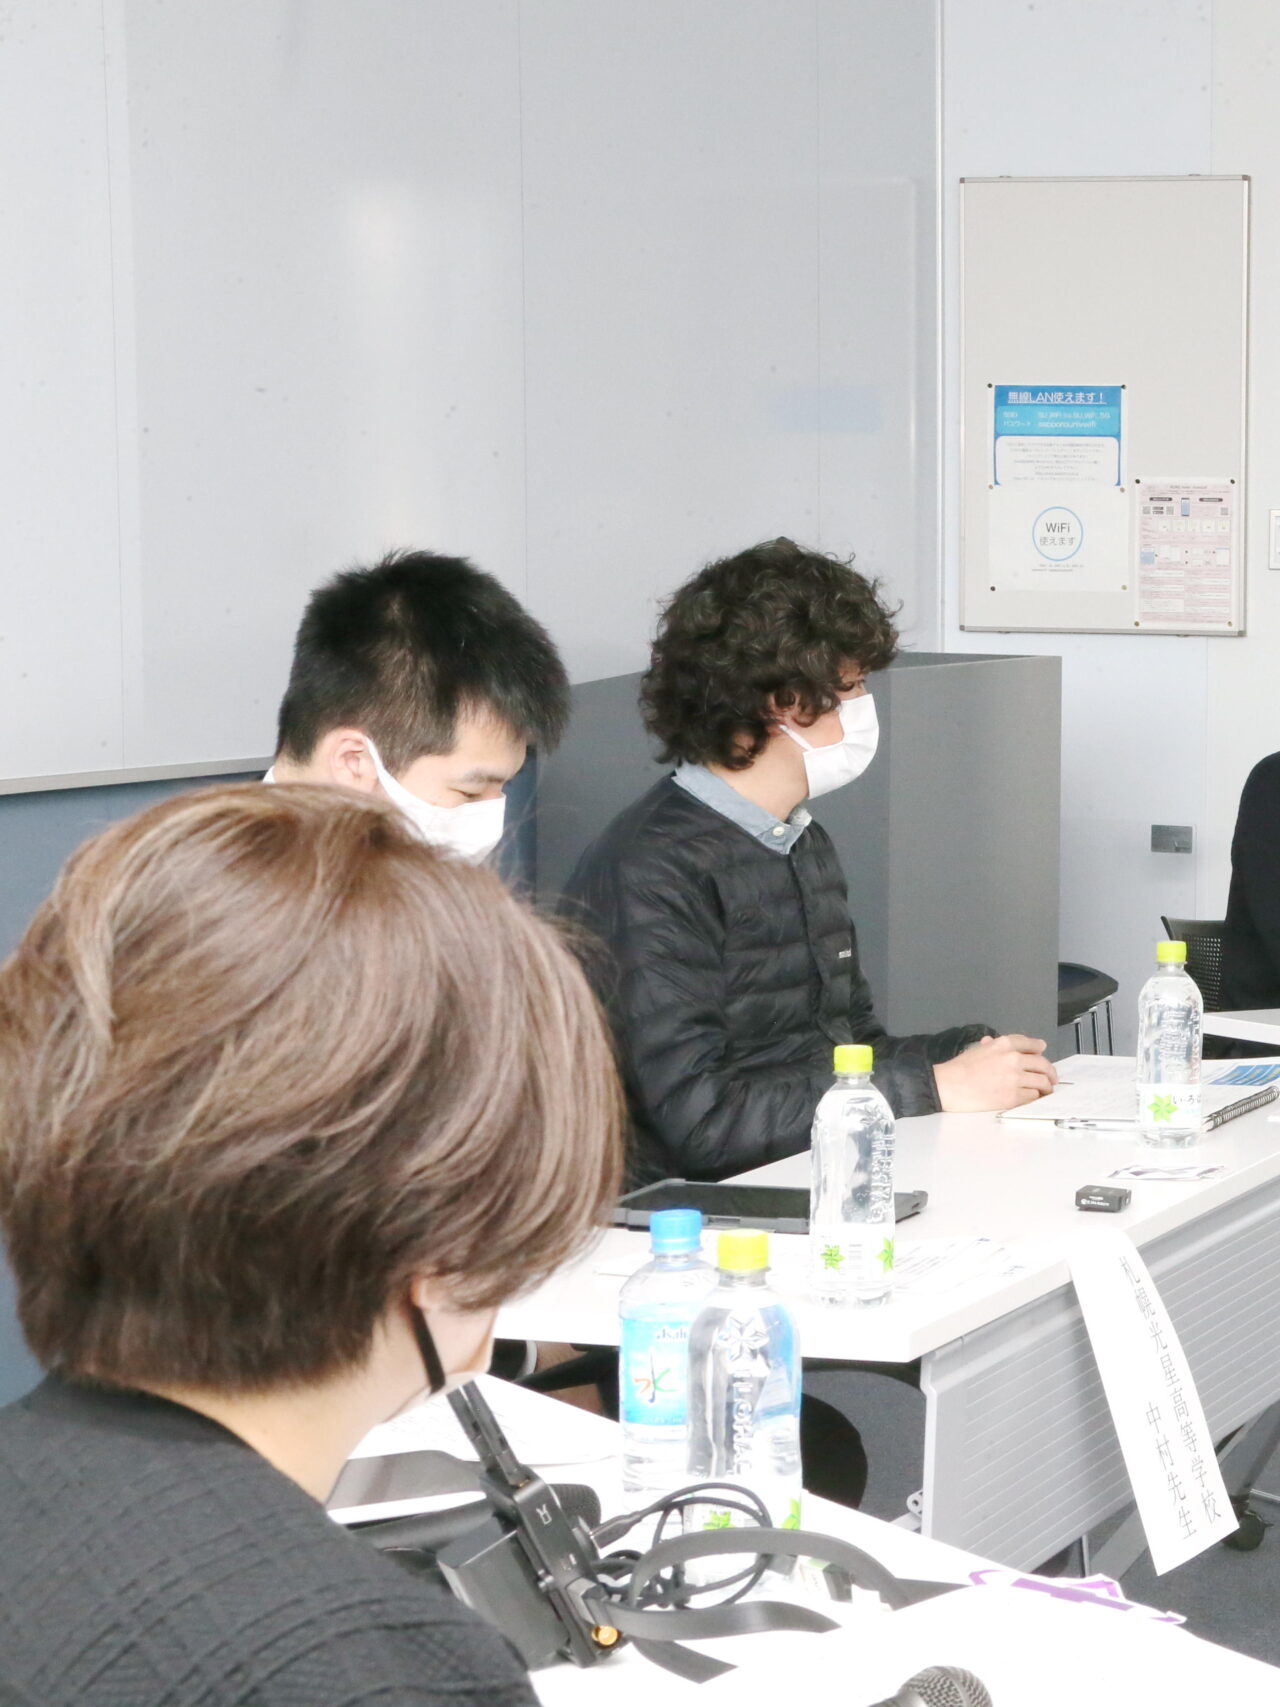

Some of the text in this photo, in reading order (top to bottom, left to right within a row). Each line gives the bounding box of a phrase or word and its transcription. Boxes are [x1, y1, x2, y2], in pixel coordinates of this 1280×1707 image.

[1039, 536, 1076, 546] 使えます
[1045, 522, 1071, 533] WiFi
[1118, 1255, 1222, 1526] 札幌光星高等学校
[1145, 1400, 1198, 1541] 中村先生
